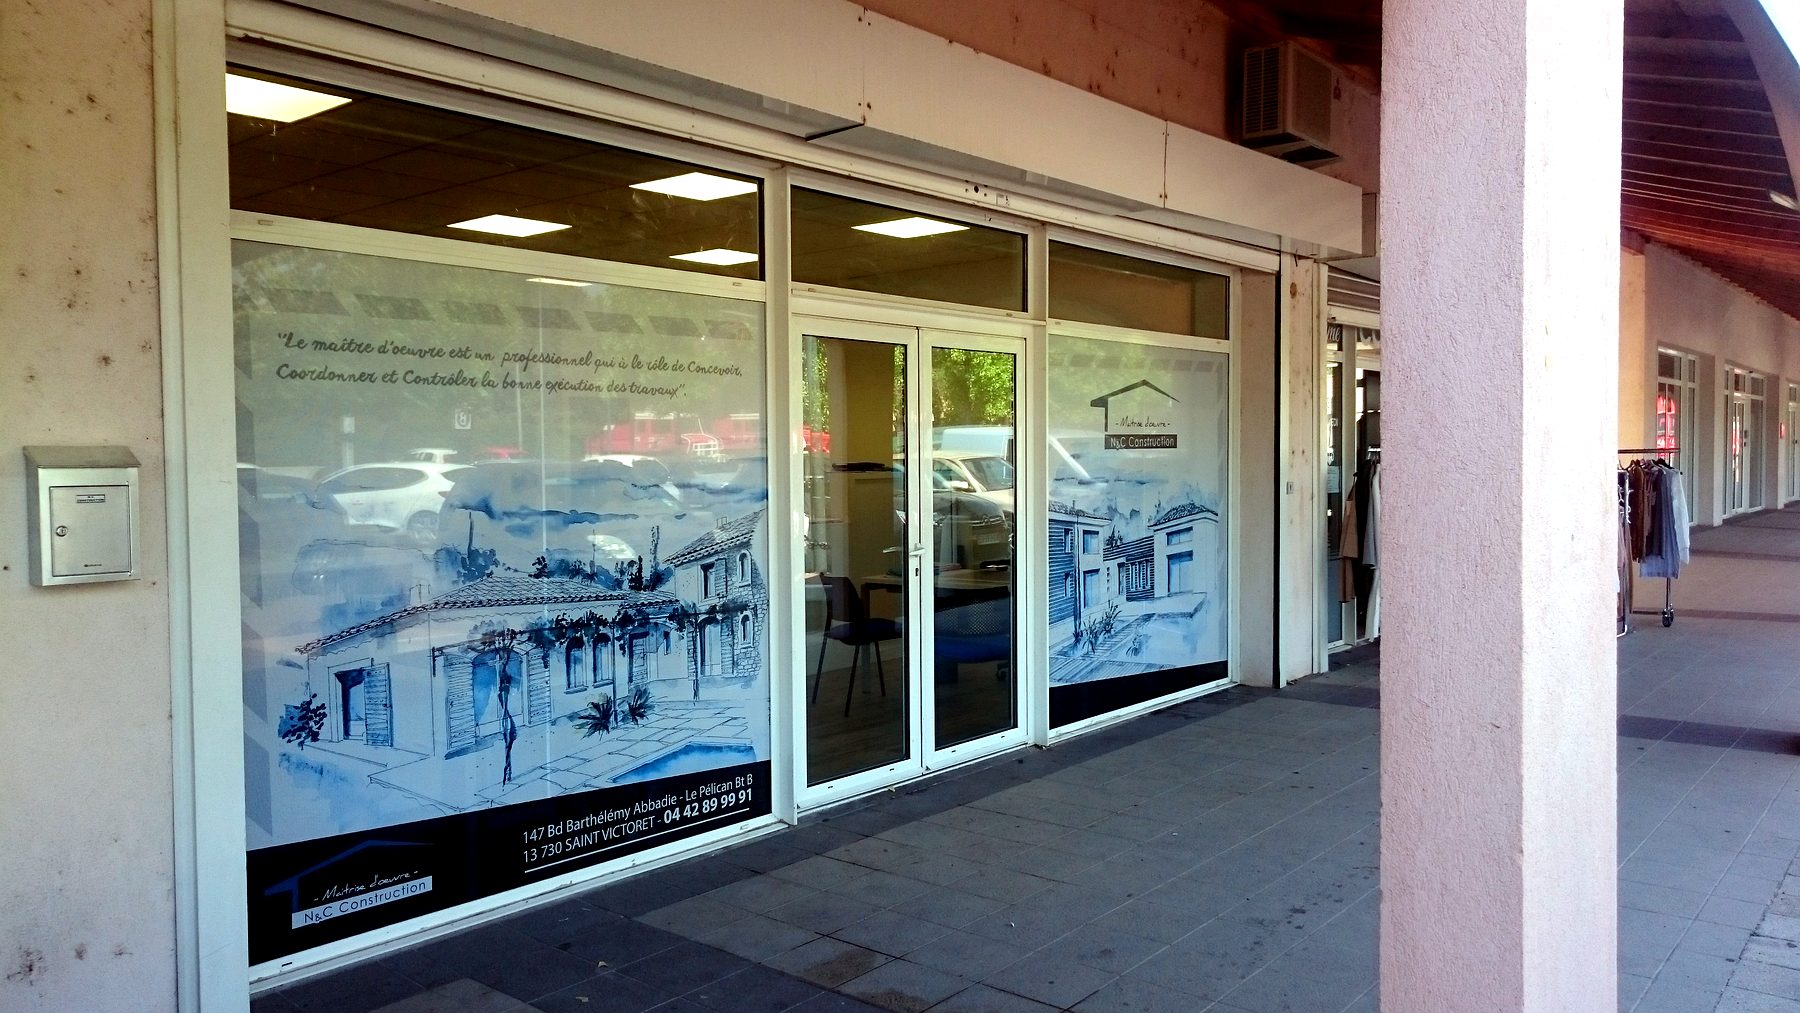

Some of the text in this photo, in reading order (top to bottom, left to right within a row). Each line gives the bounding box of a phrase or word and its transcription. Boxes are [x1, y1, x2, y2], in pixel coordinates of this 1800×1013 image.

[312, 338, 374, 354] maître
[448, 349, 472, 360] est
[475, 351, 495, 361] un
[500, 348, 593, 373] professionnel
[594, 359, 615, 374] qui
[618, 359, 628, 370] à
[631, 354, 644, 370] le
[647, 355, 669, 371] rôle
[671, 360, 686, 372] de
[276, 363, 377, 384] Coordonner
[381, 370, 399, 384] et
[402, 369, 478, 388] Contrôler
[480, 371, 499, 389] la
[501, 372, 543, 390] bonne
[545, 379, 602, 394] exécution
[606, 379, 628, 393] des
[1128, 436, 1175, 448] Construction
[523, 826, 546, 844] 147
[547, 824, 564, 838] Bd
[566, 806, 632, 833] Barthélémy
[633, 794, 678, 815] Abbadie
[685, 788, 698, 802] Le
[699, 780, 733, 797] Pélican
[735, 776, 746, 789] Bt
[746, 773, 753, 785] B
[523, 847, 539, 863] 13
[540, 840, 563, 859] 730
[565, 830, 600, 852] SAINT
[601, 815, 655, 841] VICTORET
[664, 807, 681, 824] 04
[682, 804, 700, 819] 42
[701, 797, 718, 814] 89
[720, 793, 736, 808] 99
[737, 788, 752, 802] 91
[304, 881, 427, 924] N&C Construction
